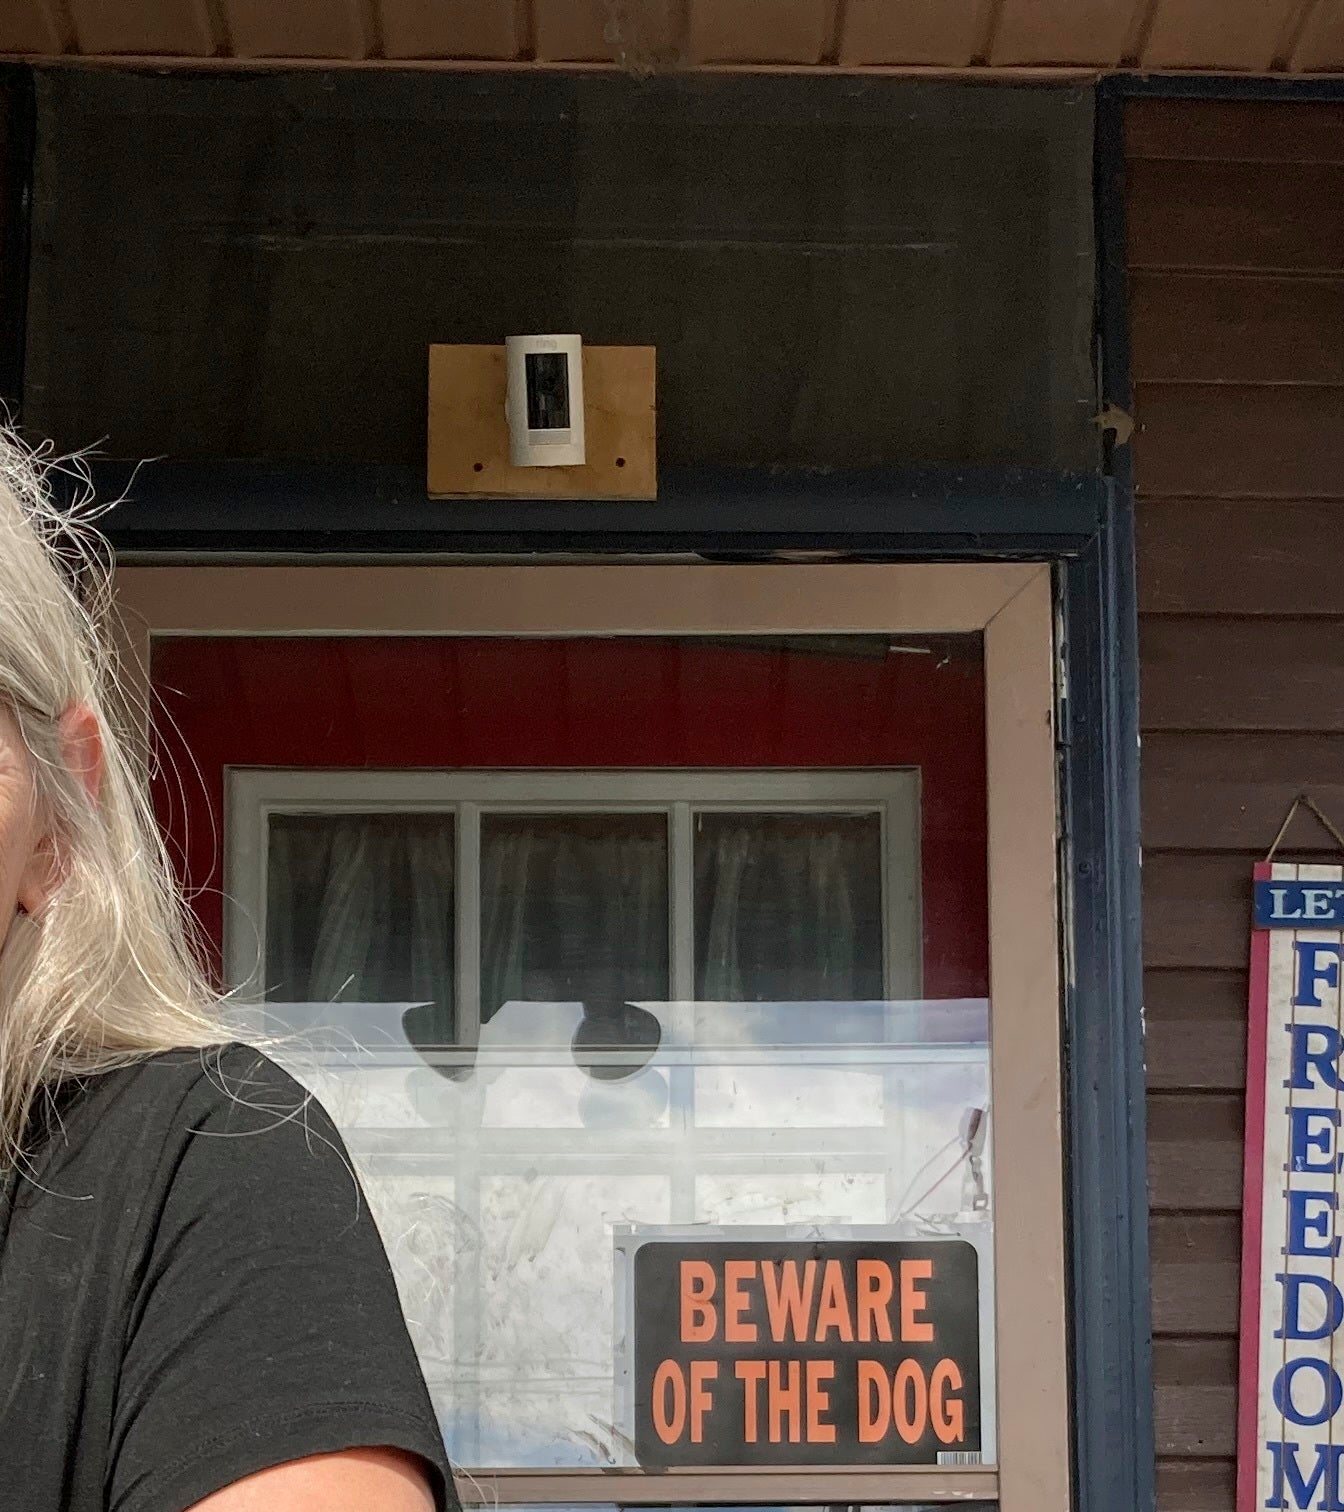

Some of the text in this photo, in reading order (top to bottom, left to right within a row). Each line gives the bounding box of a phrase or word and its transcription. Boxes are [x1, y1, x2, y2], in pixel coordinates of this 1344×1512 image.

[679, 1259, 935, 1343] BEWARE
[651, 1357, 965, 1445] OF THE DOG
